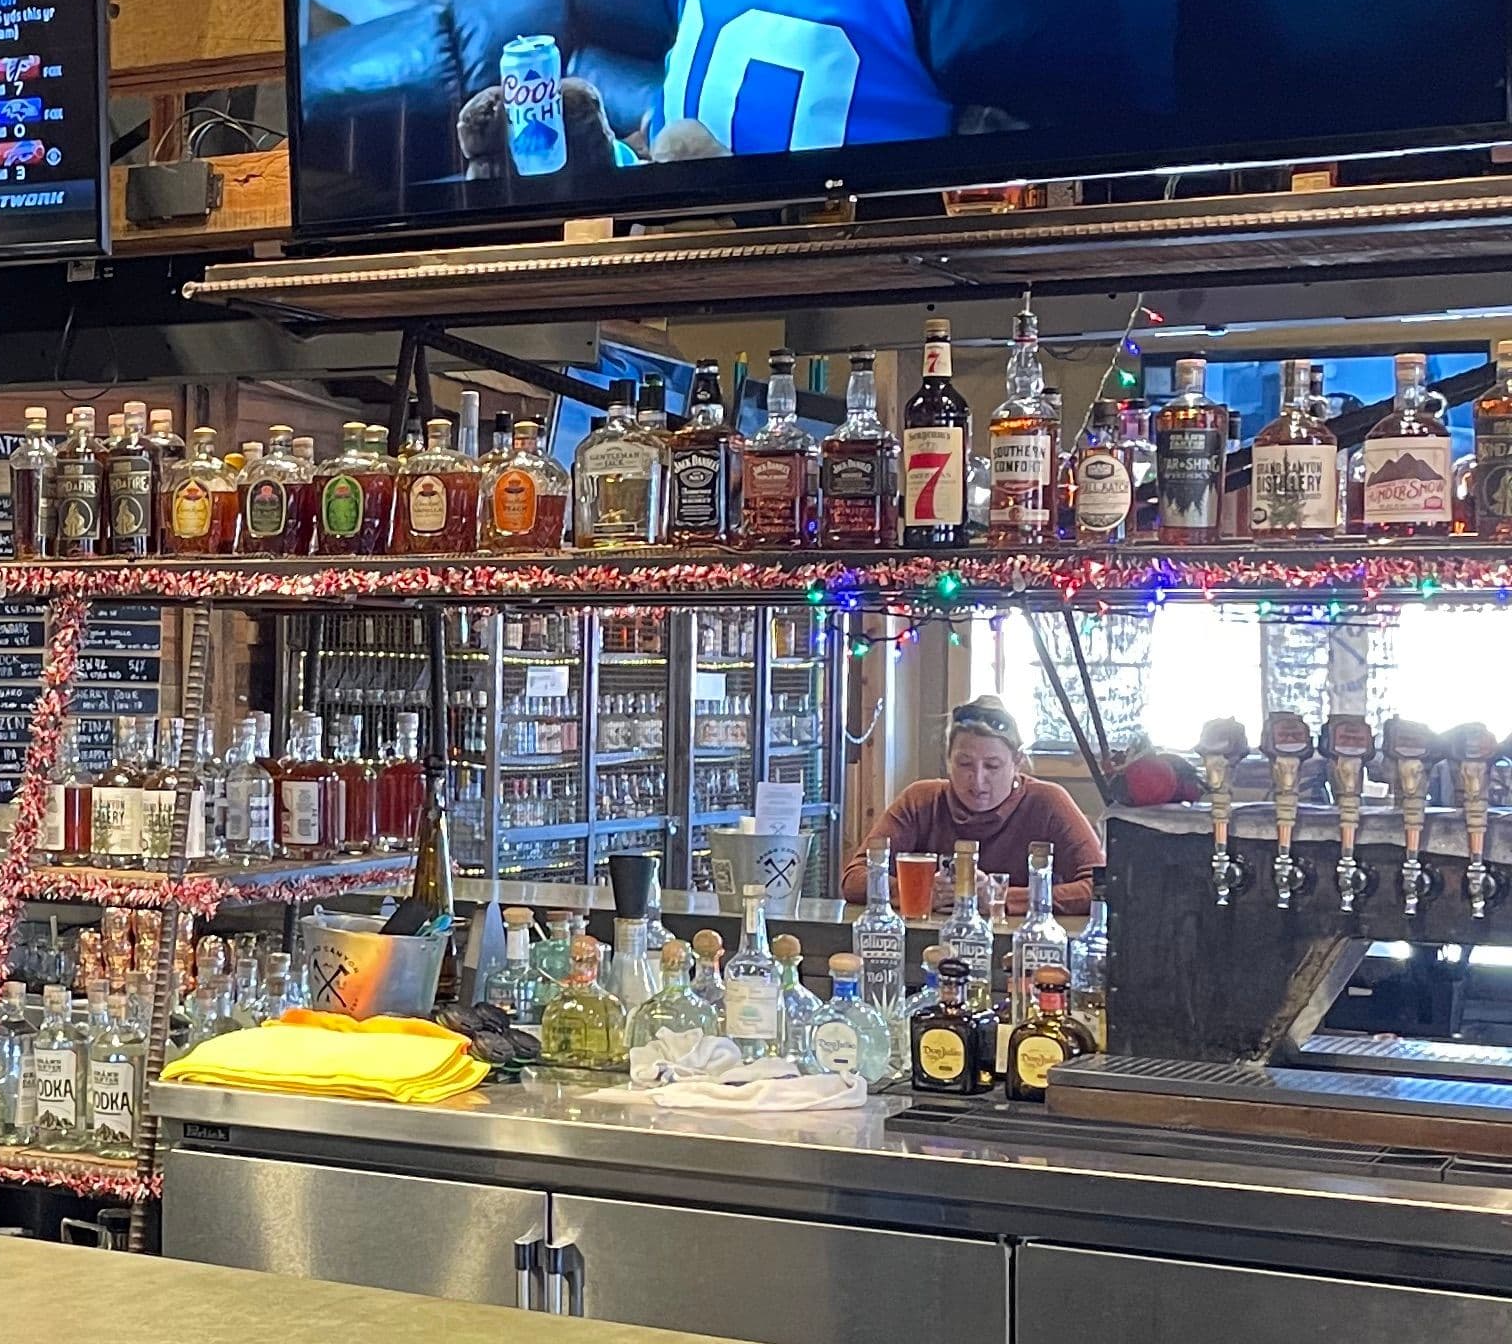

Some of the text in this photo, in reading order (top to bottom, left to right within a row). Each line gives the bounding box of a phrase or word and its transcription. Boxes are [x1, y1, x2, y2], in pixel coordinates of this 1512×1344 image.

[4, 9, 21, 26] yds
[23, 6, 41, 21] this
[13, 81, 24, 96] 7
[14, 124, 26, 137] 0
[16, 165, 26, 180] 3
[927, 351, 941, 373] 7
[993, 444, 1047, 457] SOUTHERN
[908, 450, 953, 520] 7
[1257, 474, 1323, 493] DISTILLERY
[38, 1079, 75, 1098] ODKA
[94, 1091, 131, 1111] ODKA
